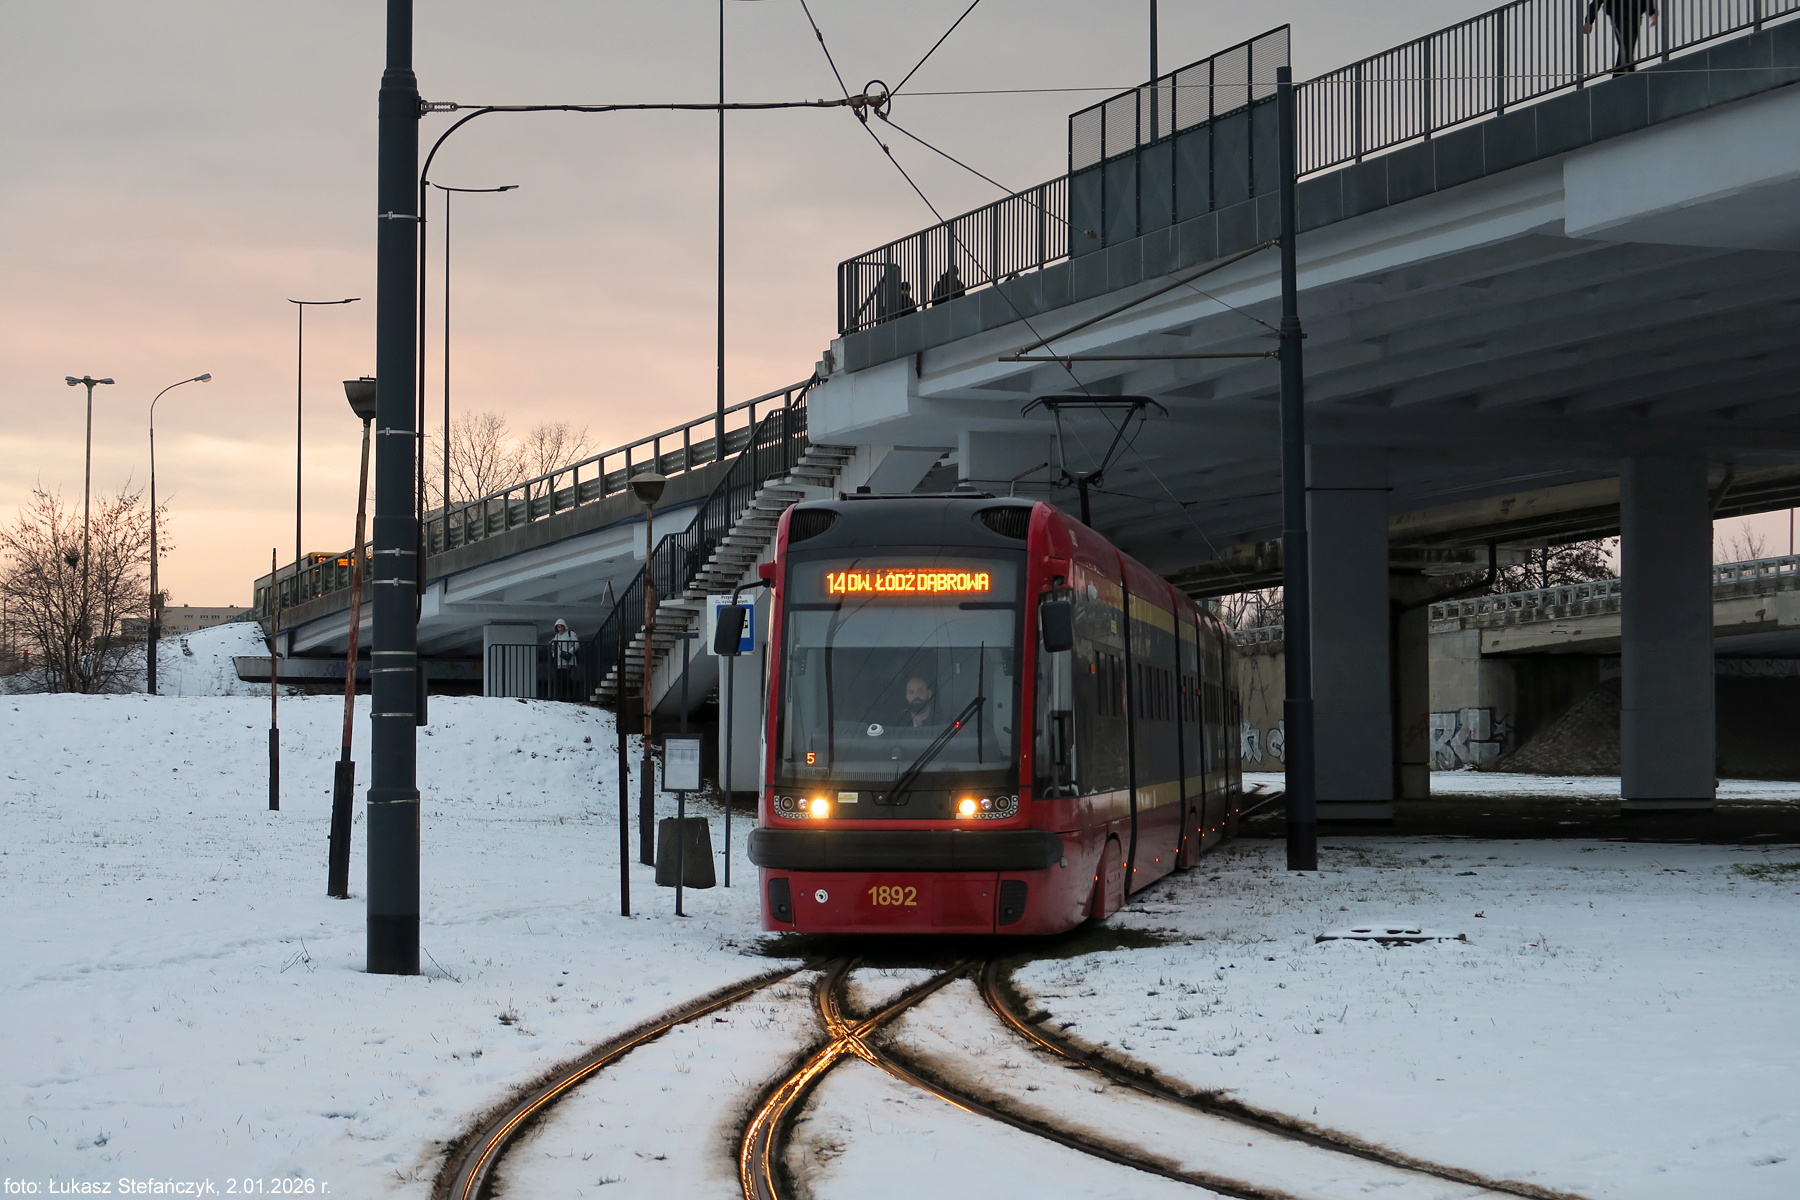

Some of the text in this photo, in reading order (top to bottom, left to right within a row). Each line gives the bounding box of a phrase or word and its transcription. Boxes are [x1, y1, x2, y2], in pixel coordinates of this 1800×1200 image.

[826, 571, 846, 594] 14
[847, 571, 989, 593] DW. ŁÓDŹ DĄBROWA
[806, 752, 816, 765] 5
[868, 886, 917, 906] 1892
